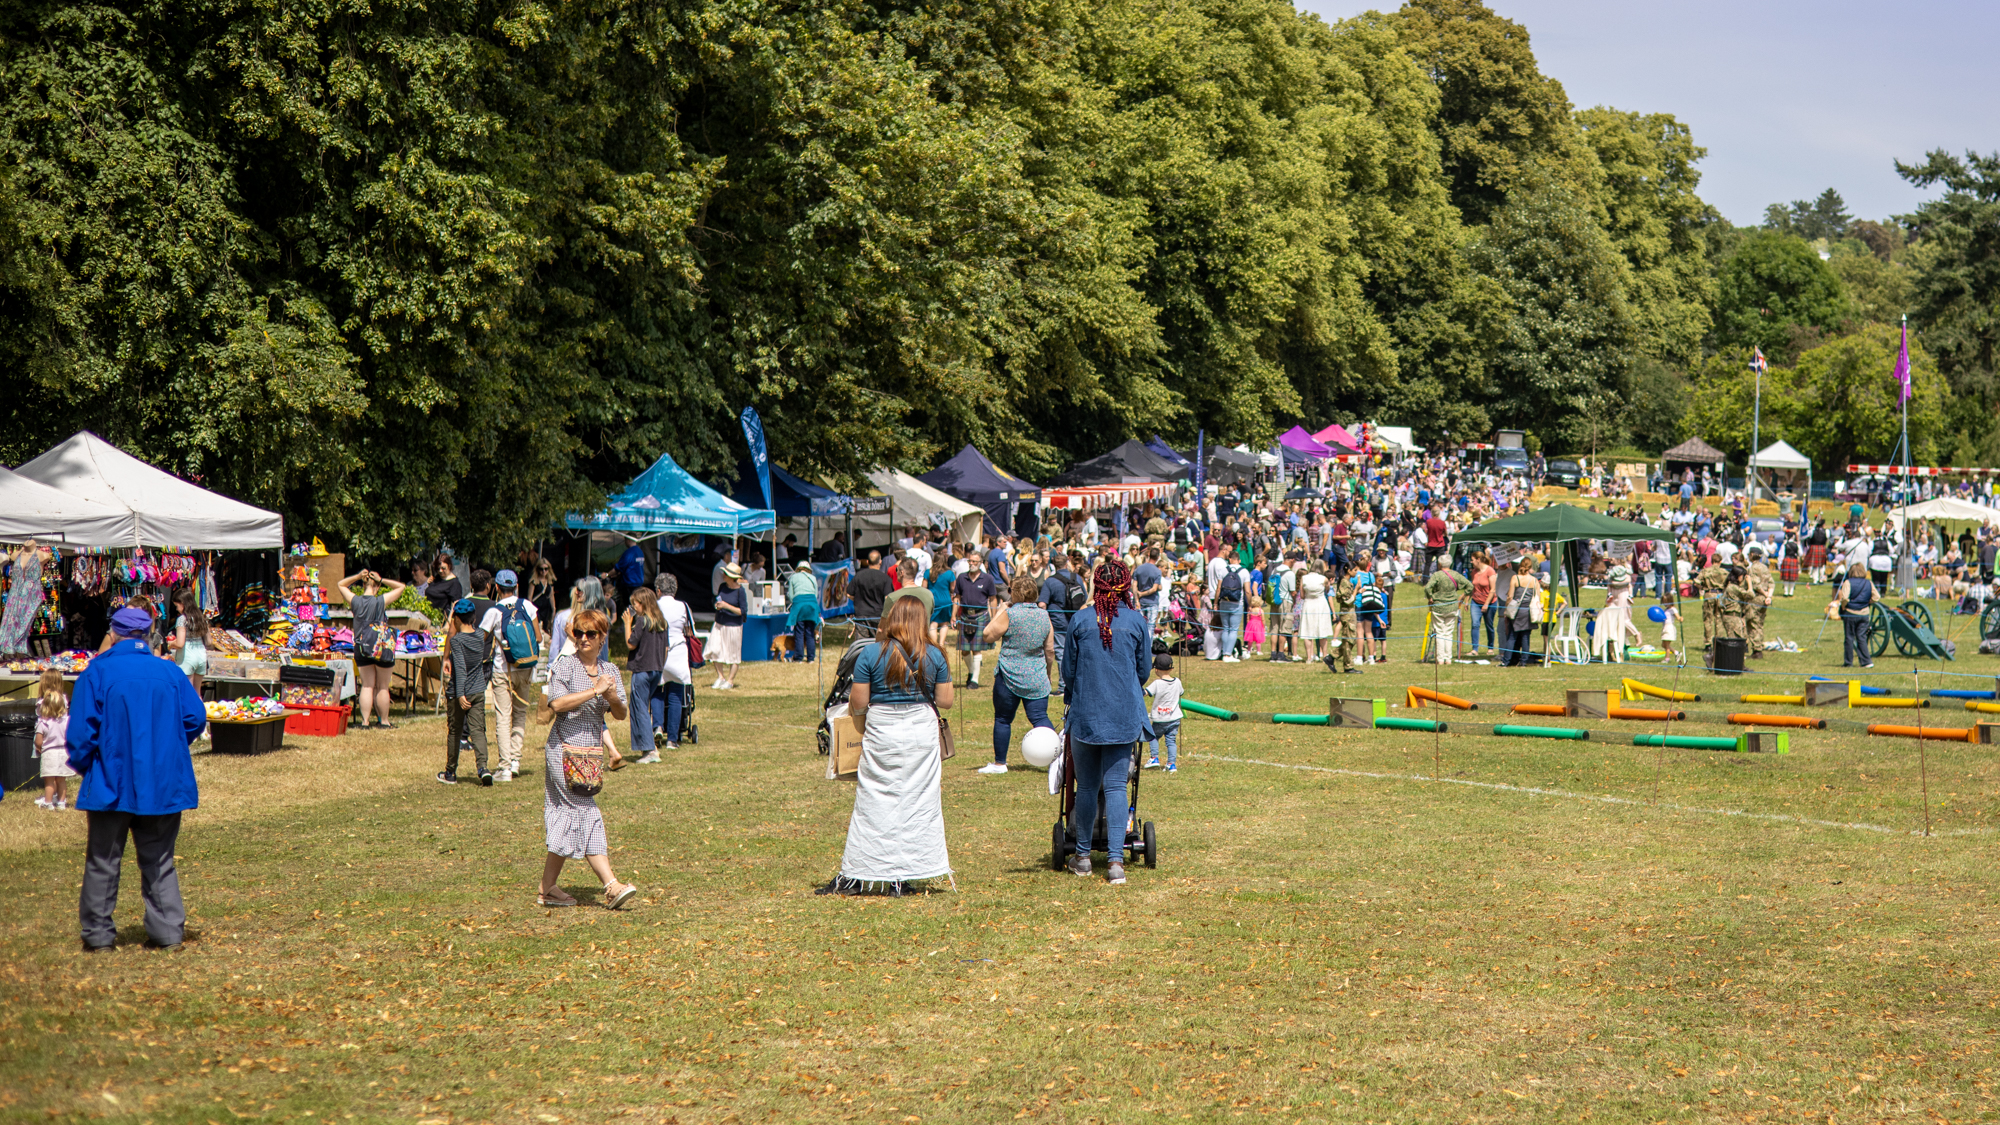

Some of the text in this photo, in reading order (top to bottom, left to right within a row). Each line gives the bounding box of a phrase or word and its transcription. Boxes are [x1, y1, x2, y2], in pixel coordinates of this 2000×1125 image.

[614, 515, 646, 524] WATER
[647, 516, 672, 525] SAVE
[694, 518, 733, 528] MONEY?
